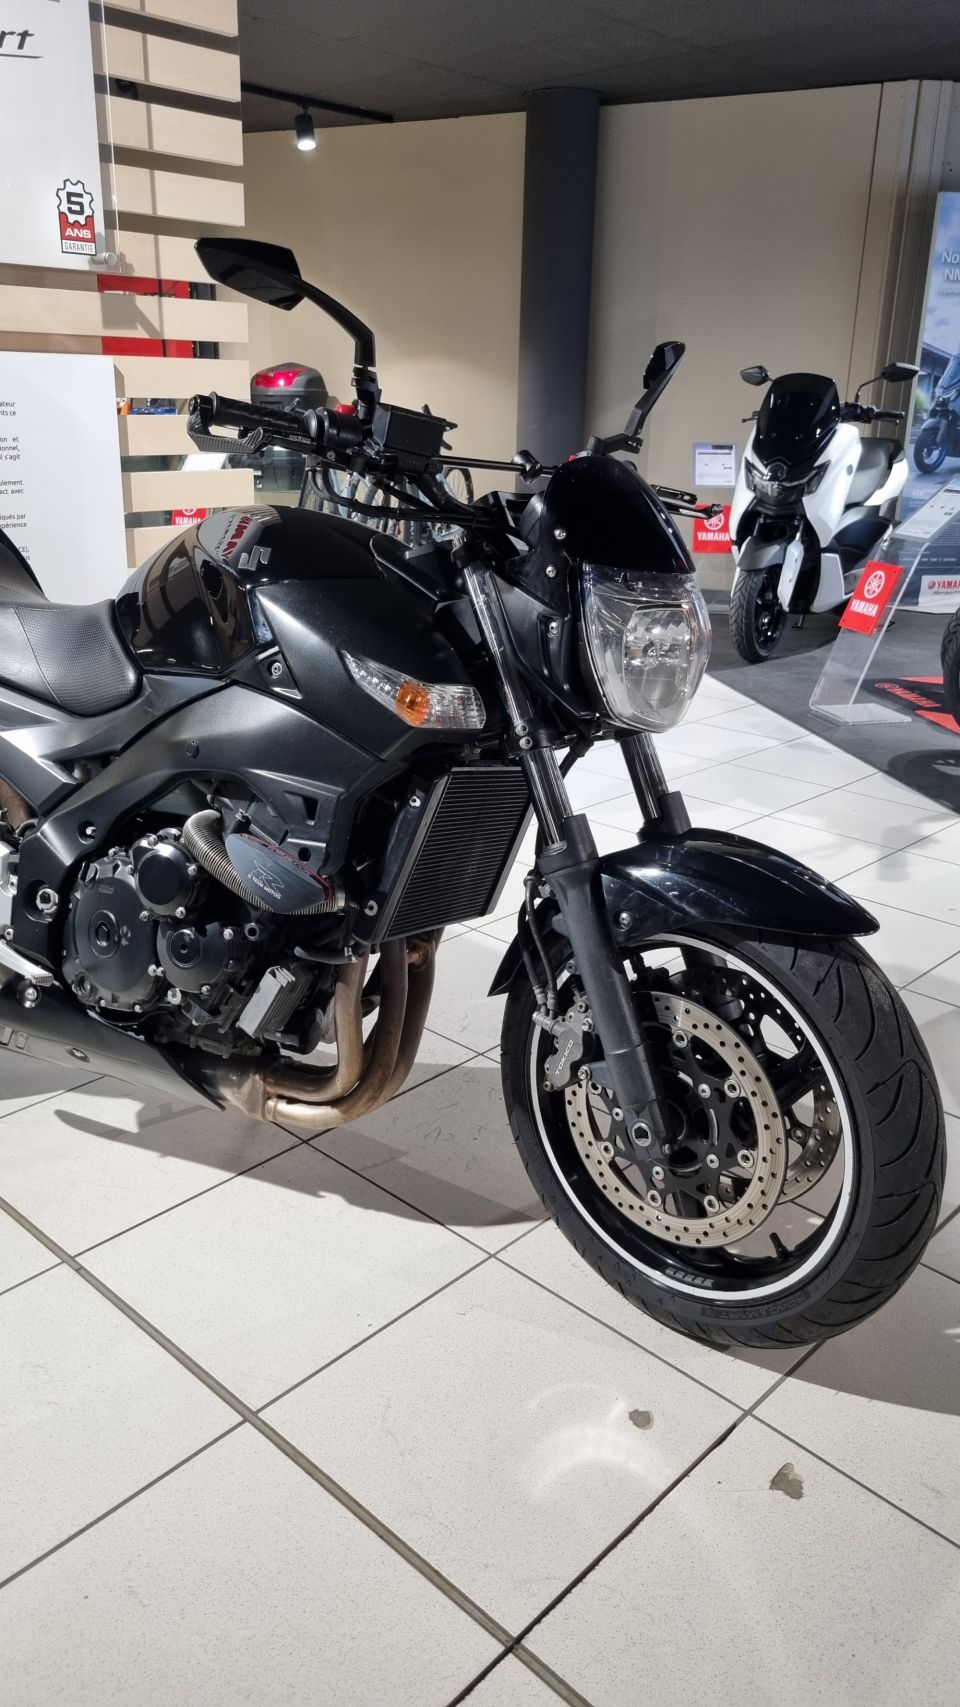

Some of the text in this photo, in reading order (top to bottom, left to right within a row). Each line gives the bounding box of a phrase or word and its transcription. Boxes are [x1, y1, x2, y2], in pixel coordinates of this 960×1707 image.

[66, 191, 85, 215] 5
[65, 227, 91, 239] ANS
[64, 241, 94, 253] GARANTIE
[697, 531, 731, 541] YAMAHA
[850, 598, 879, 617] YAMAHA
[555, 1040, 573, 1075] TOKICO
